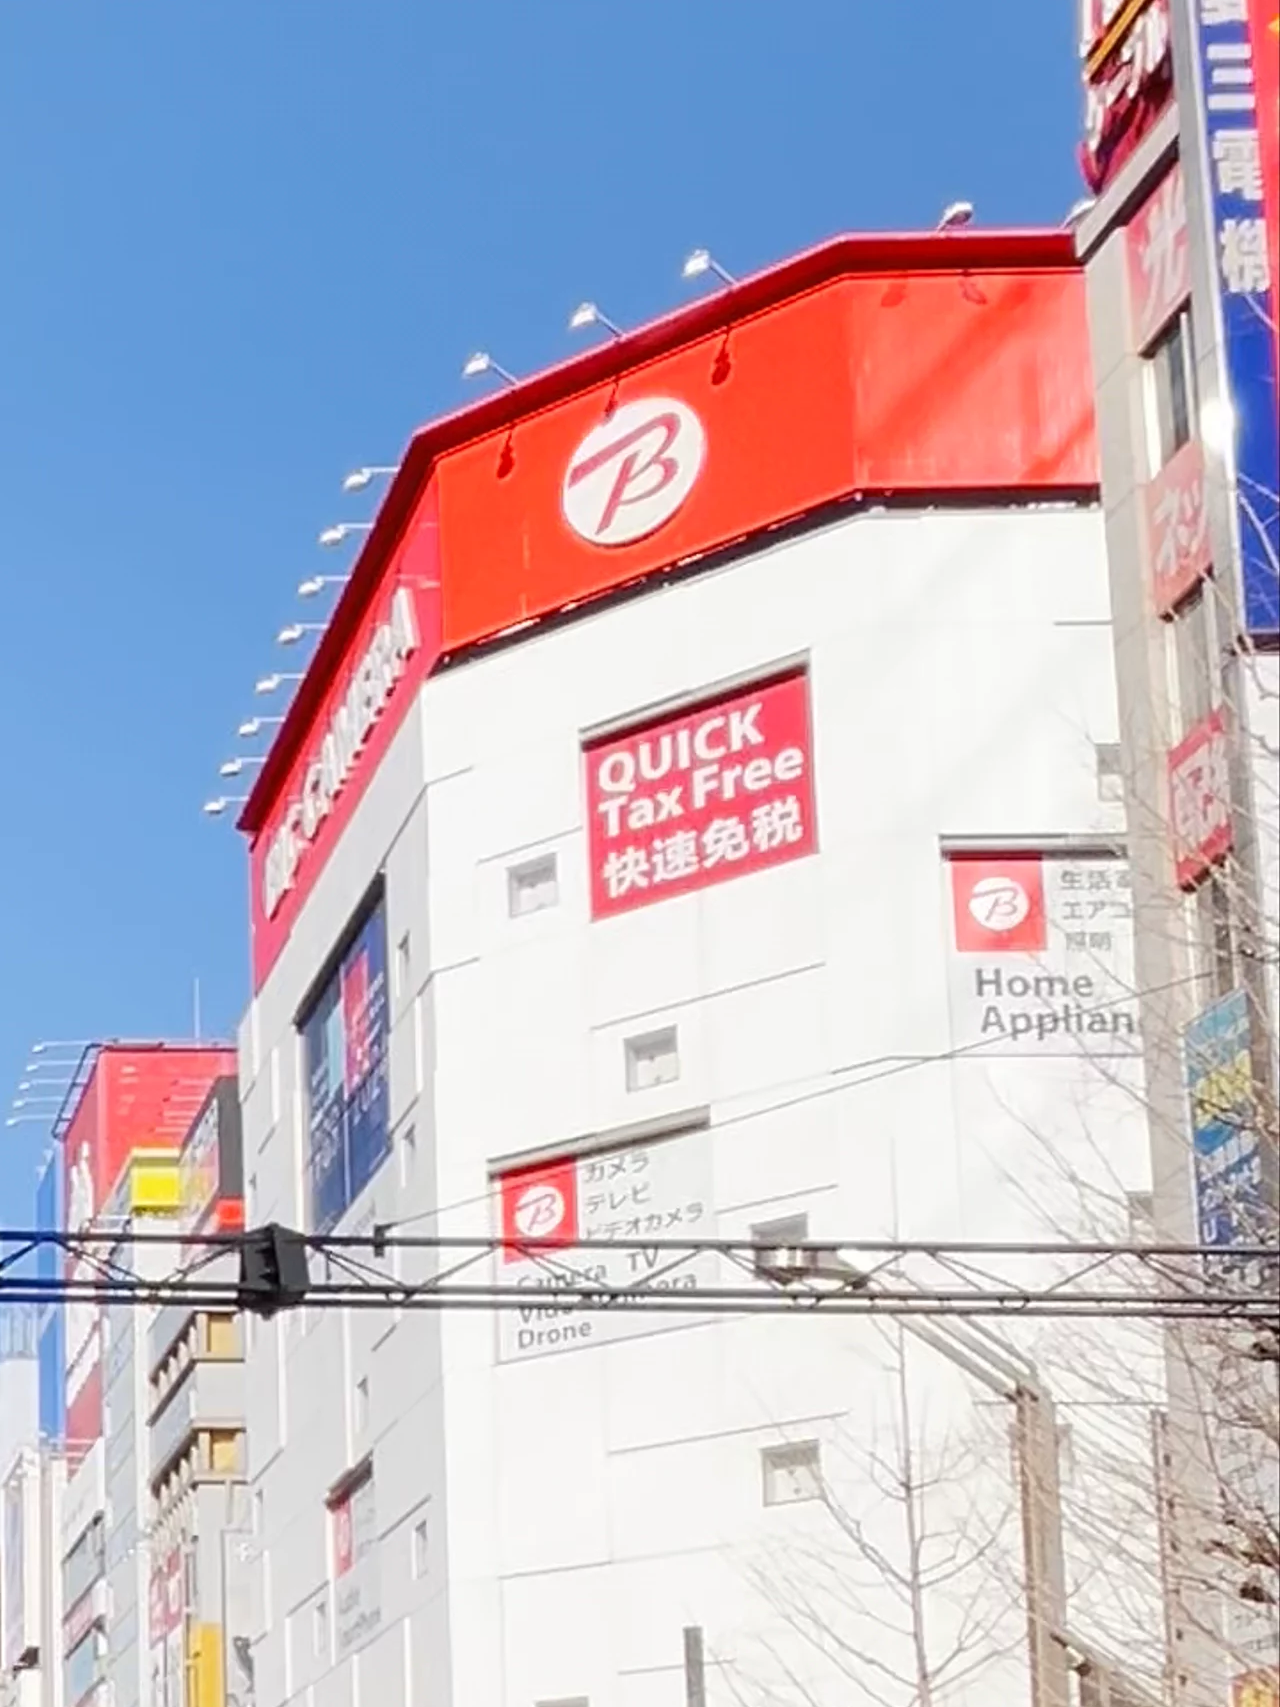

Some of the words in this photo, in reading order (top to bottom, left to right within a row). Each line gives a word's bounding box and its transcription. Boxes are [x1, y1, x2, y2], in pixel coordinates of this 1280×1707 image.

[598, 702, 766, 795] QUICK
[597, 786, 685, 839] Tax
[692, 746, 806, 810] Free
[603, 795, 806, 900] 快速免税
[974, 966, 1095, 998] Home
[582, 1150, 650, 1185] カメラ
[586, 1183, 652, 1215] テレビ
[626, 1245, 661, 1273] TV
[518, 1320, 594, 1350] Drone
